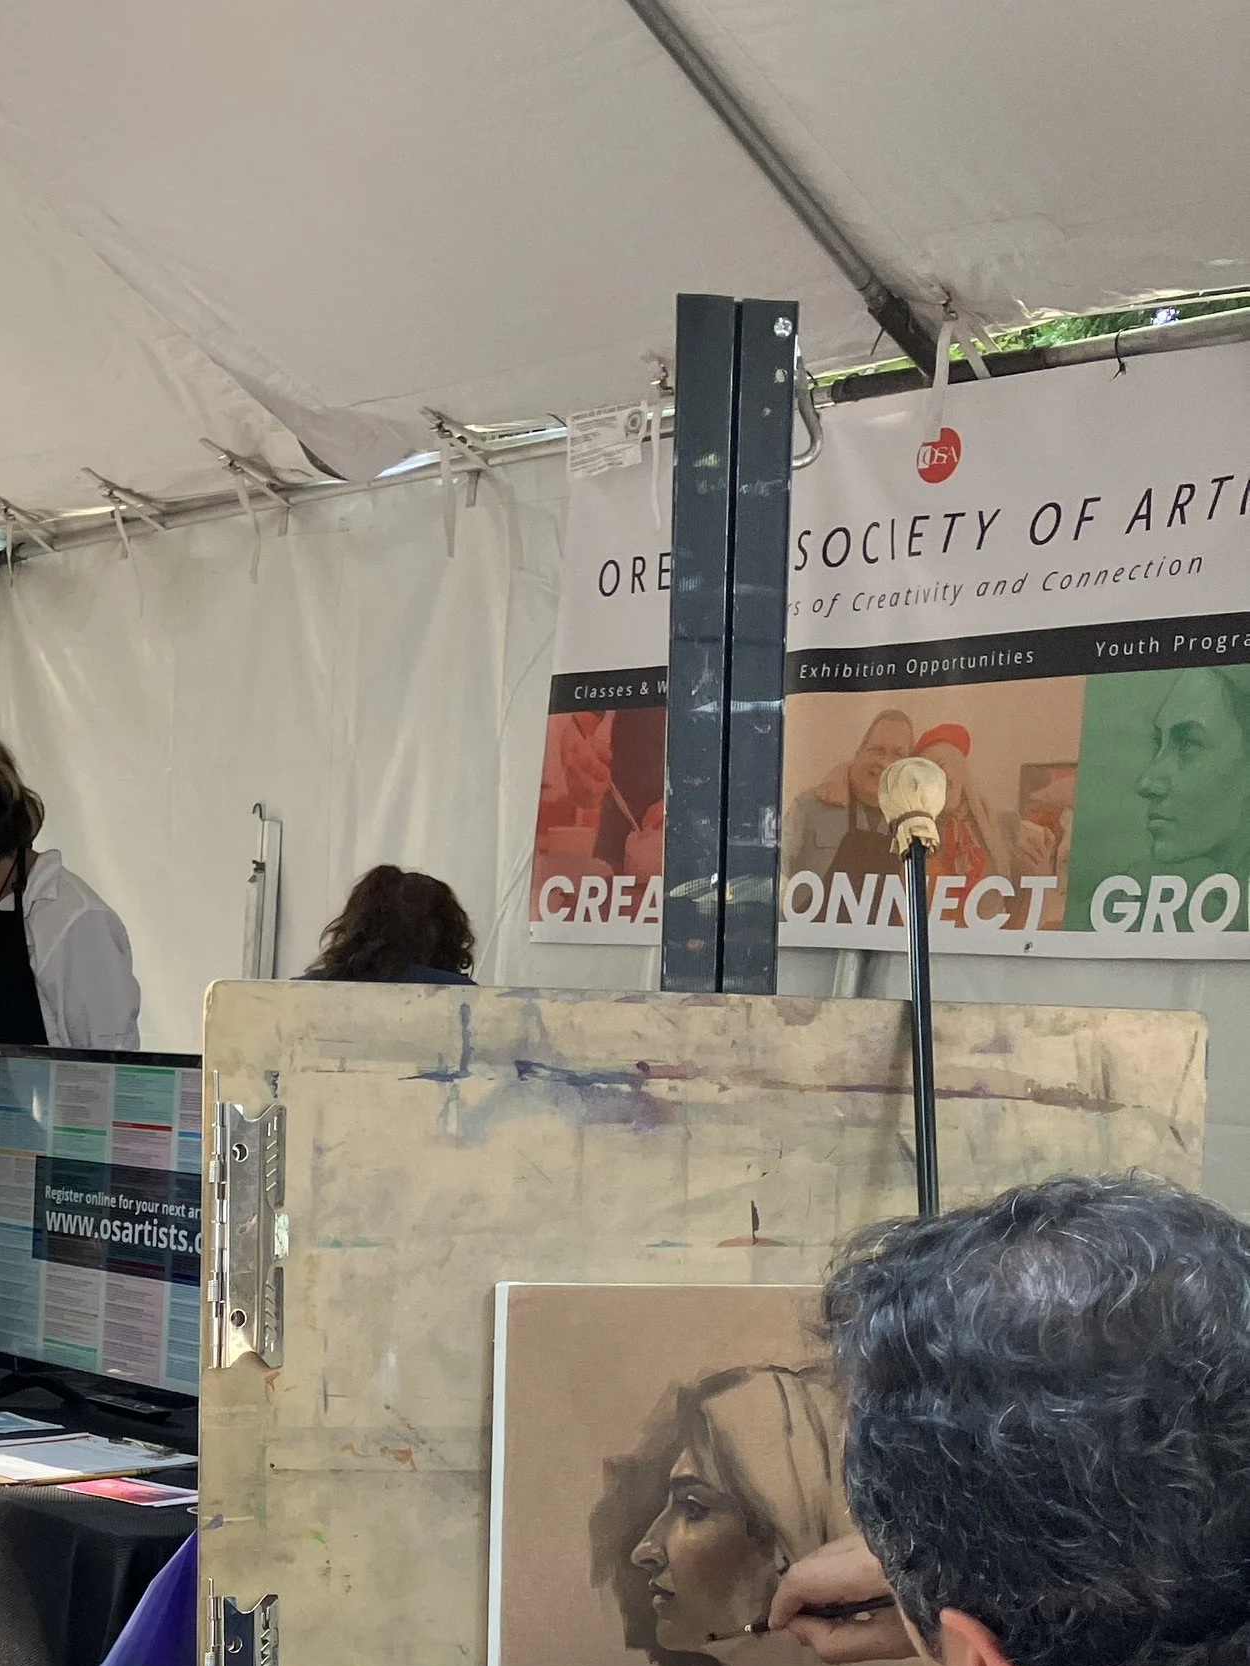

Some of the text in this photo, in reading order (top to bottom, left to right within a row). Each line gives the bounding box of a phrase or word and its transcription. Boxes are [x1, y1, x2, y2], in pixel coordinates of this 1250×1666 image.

[598, 473, 1250, 598] ORE SOCIETY OF ARTI
[812, 592, 841, 618] of
[852, 581, 963, 612] Creativity
[976, 573, 1029, 597] and
[1042, 555, 1203, 592] Connection
[799, 649, 1034, 679] Exhibition Opportunities
[1095, 633, 1250, 657] Youth Progra
[574, 682, 633, 700] Classes
[639, 681, 649, 695] &
[538, 870, 1057, 931] CREA ONNECT
[1090, 873, 1250, 933] GRO
[44, 1185, 202, 1219] Register online for your next ar
[45, 1210, 202, 1254] www.osartists.c
